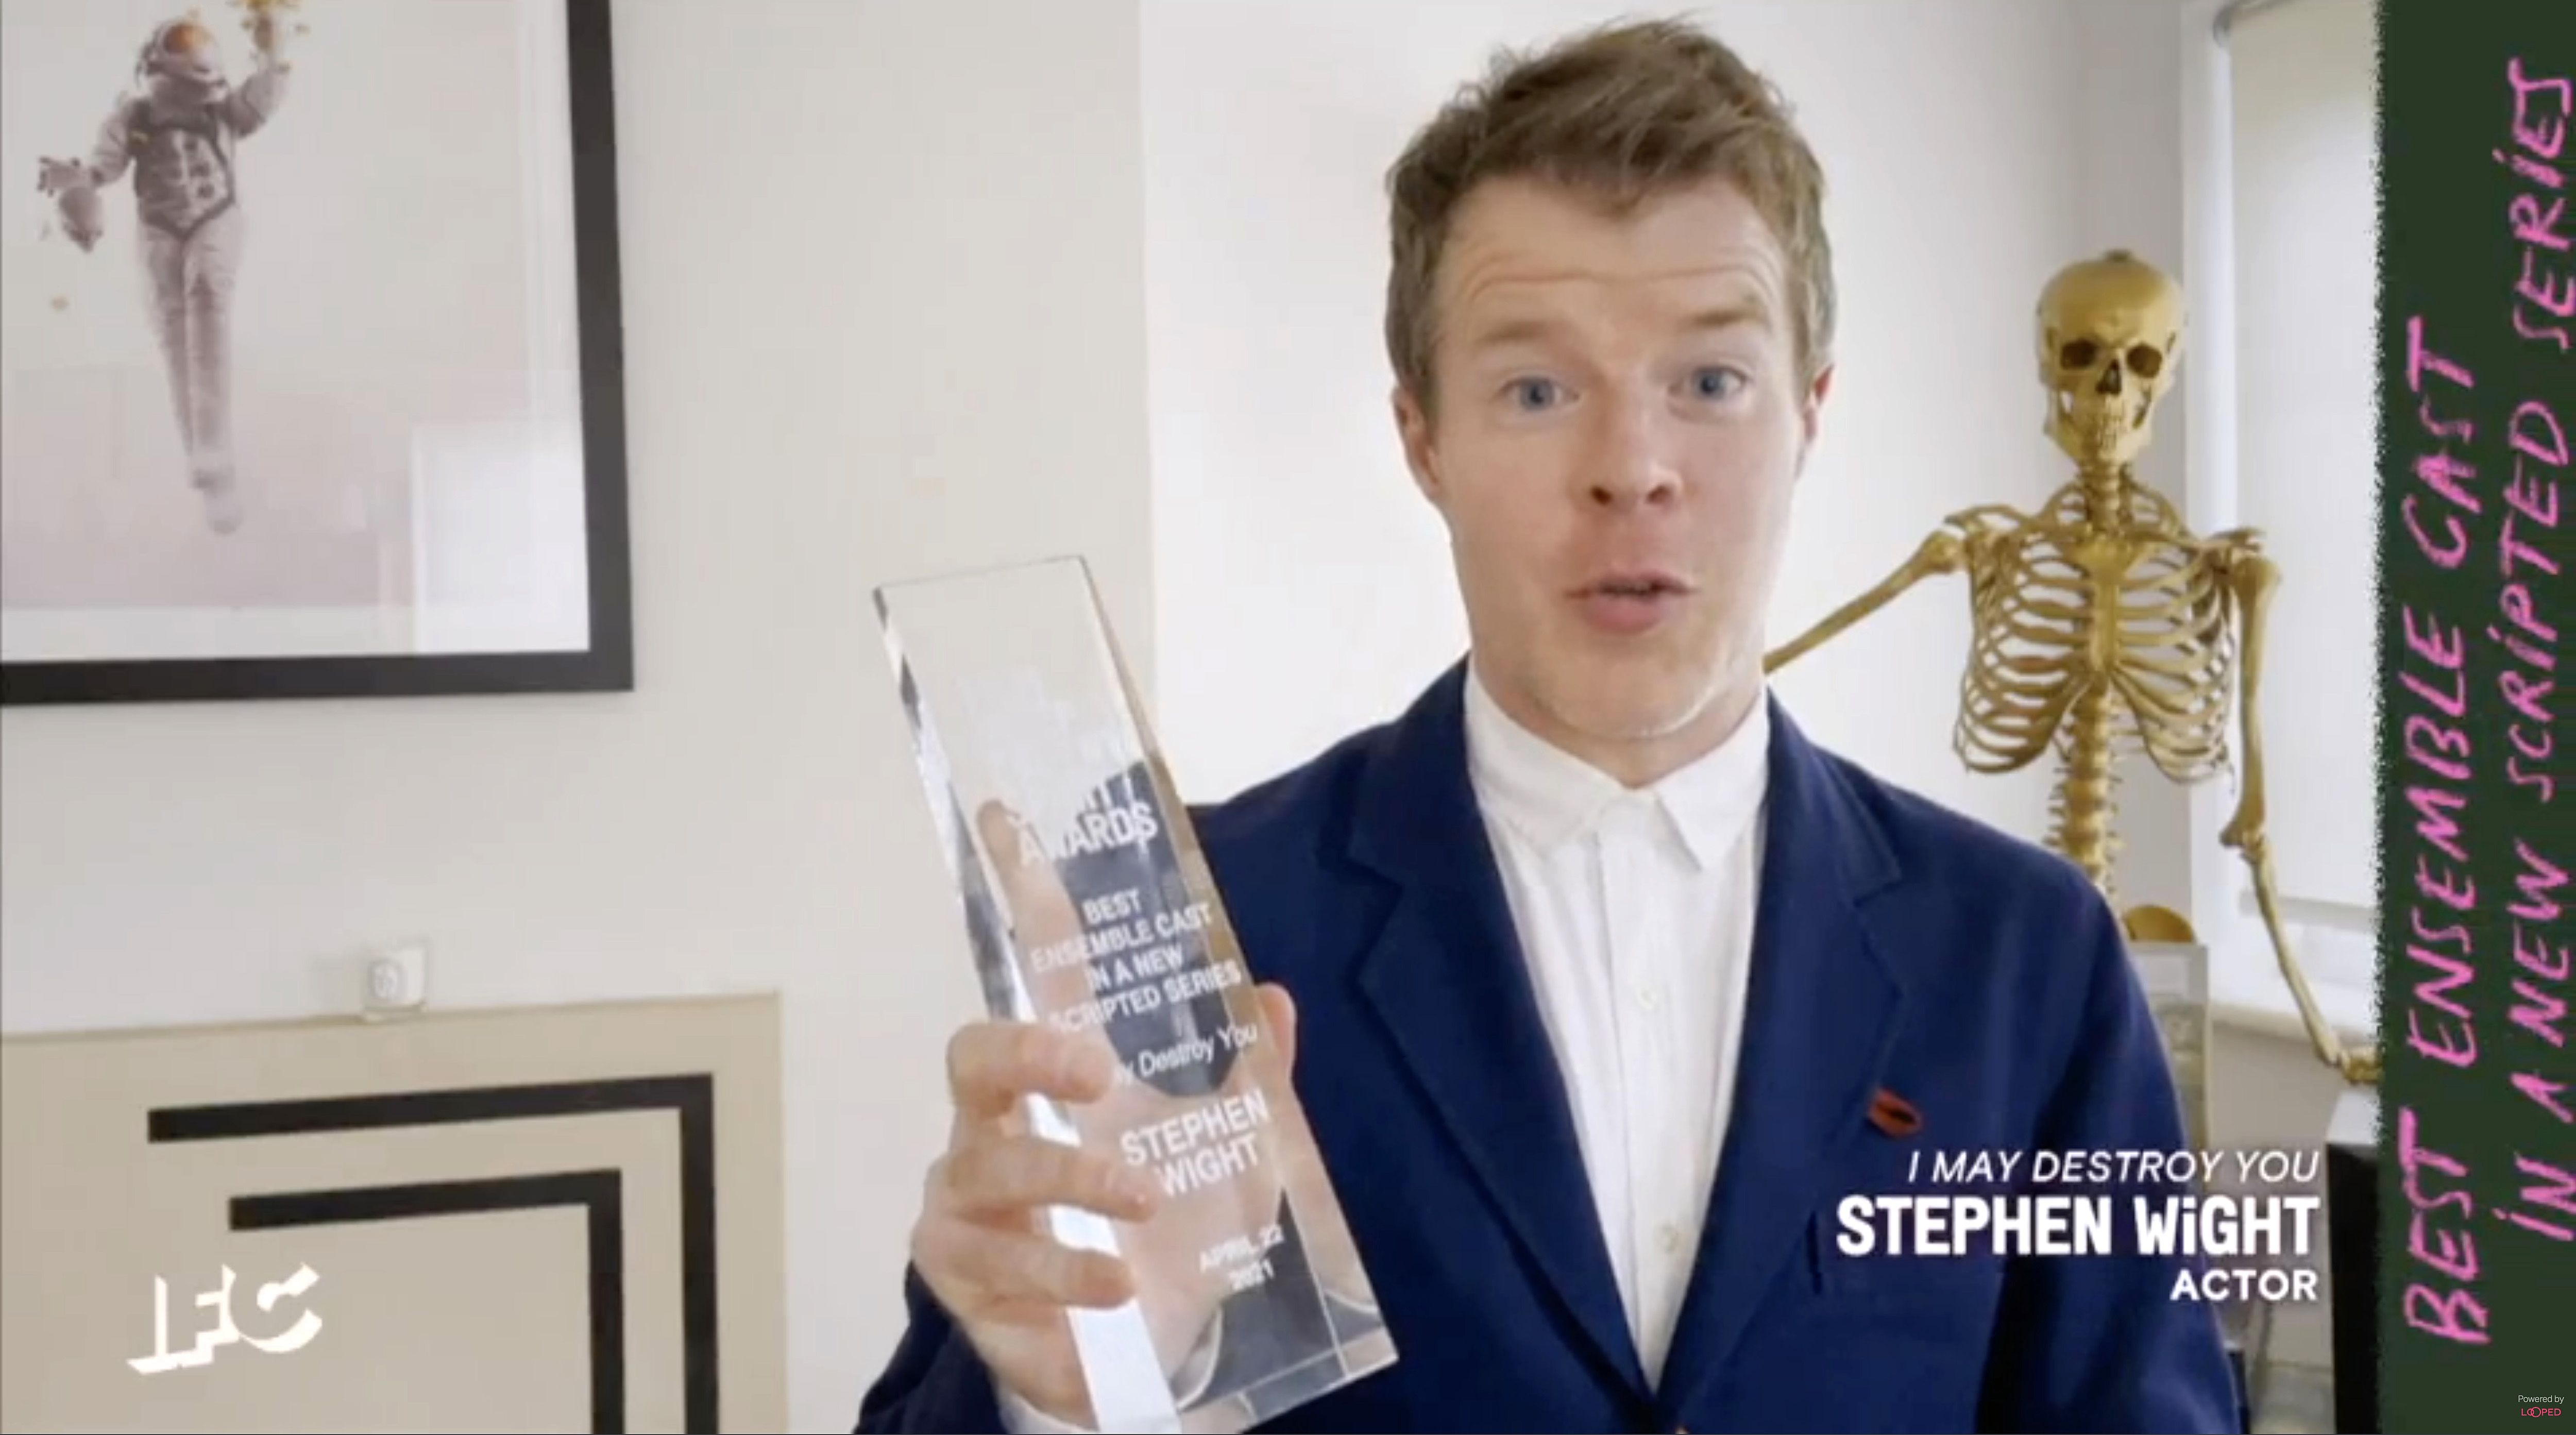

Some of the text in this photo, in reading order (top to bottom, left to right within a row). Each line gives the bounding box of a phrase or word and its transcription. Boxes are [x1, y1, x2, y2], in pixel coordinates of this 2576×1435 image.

[1083, 888, 1142, 925] BEST
[1031, 902, 1212, 973] ENSEMBLE CAST
[1114, 957, 1134, 986] A
[1133, 942, 1184, 979] NEW
[1162, 959, 1242, 1004] SERIES
[1138, 1036, 1215, 1077] Destroy
[1216, 1023, 1259, 1051] You
[1120, 1086, 1270, 1167] STEPHEN
[1152, 1133, 1259, 1198] WIGHT
